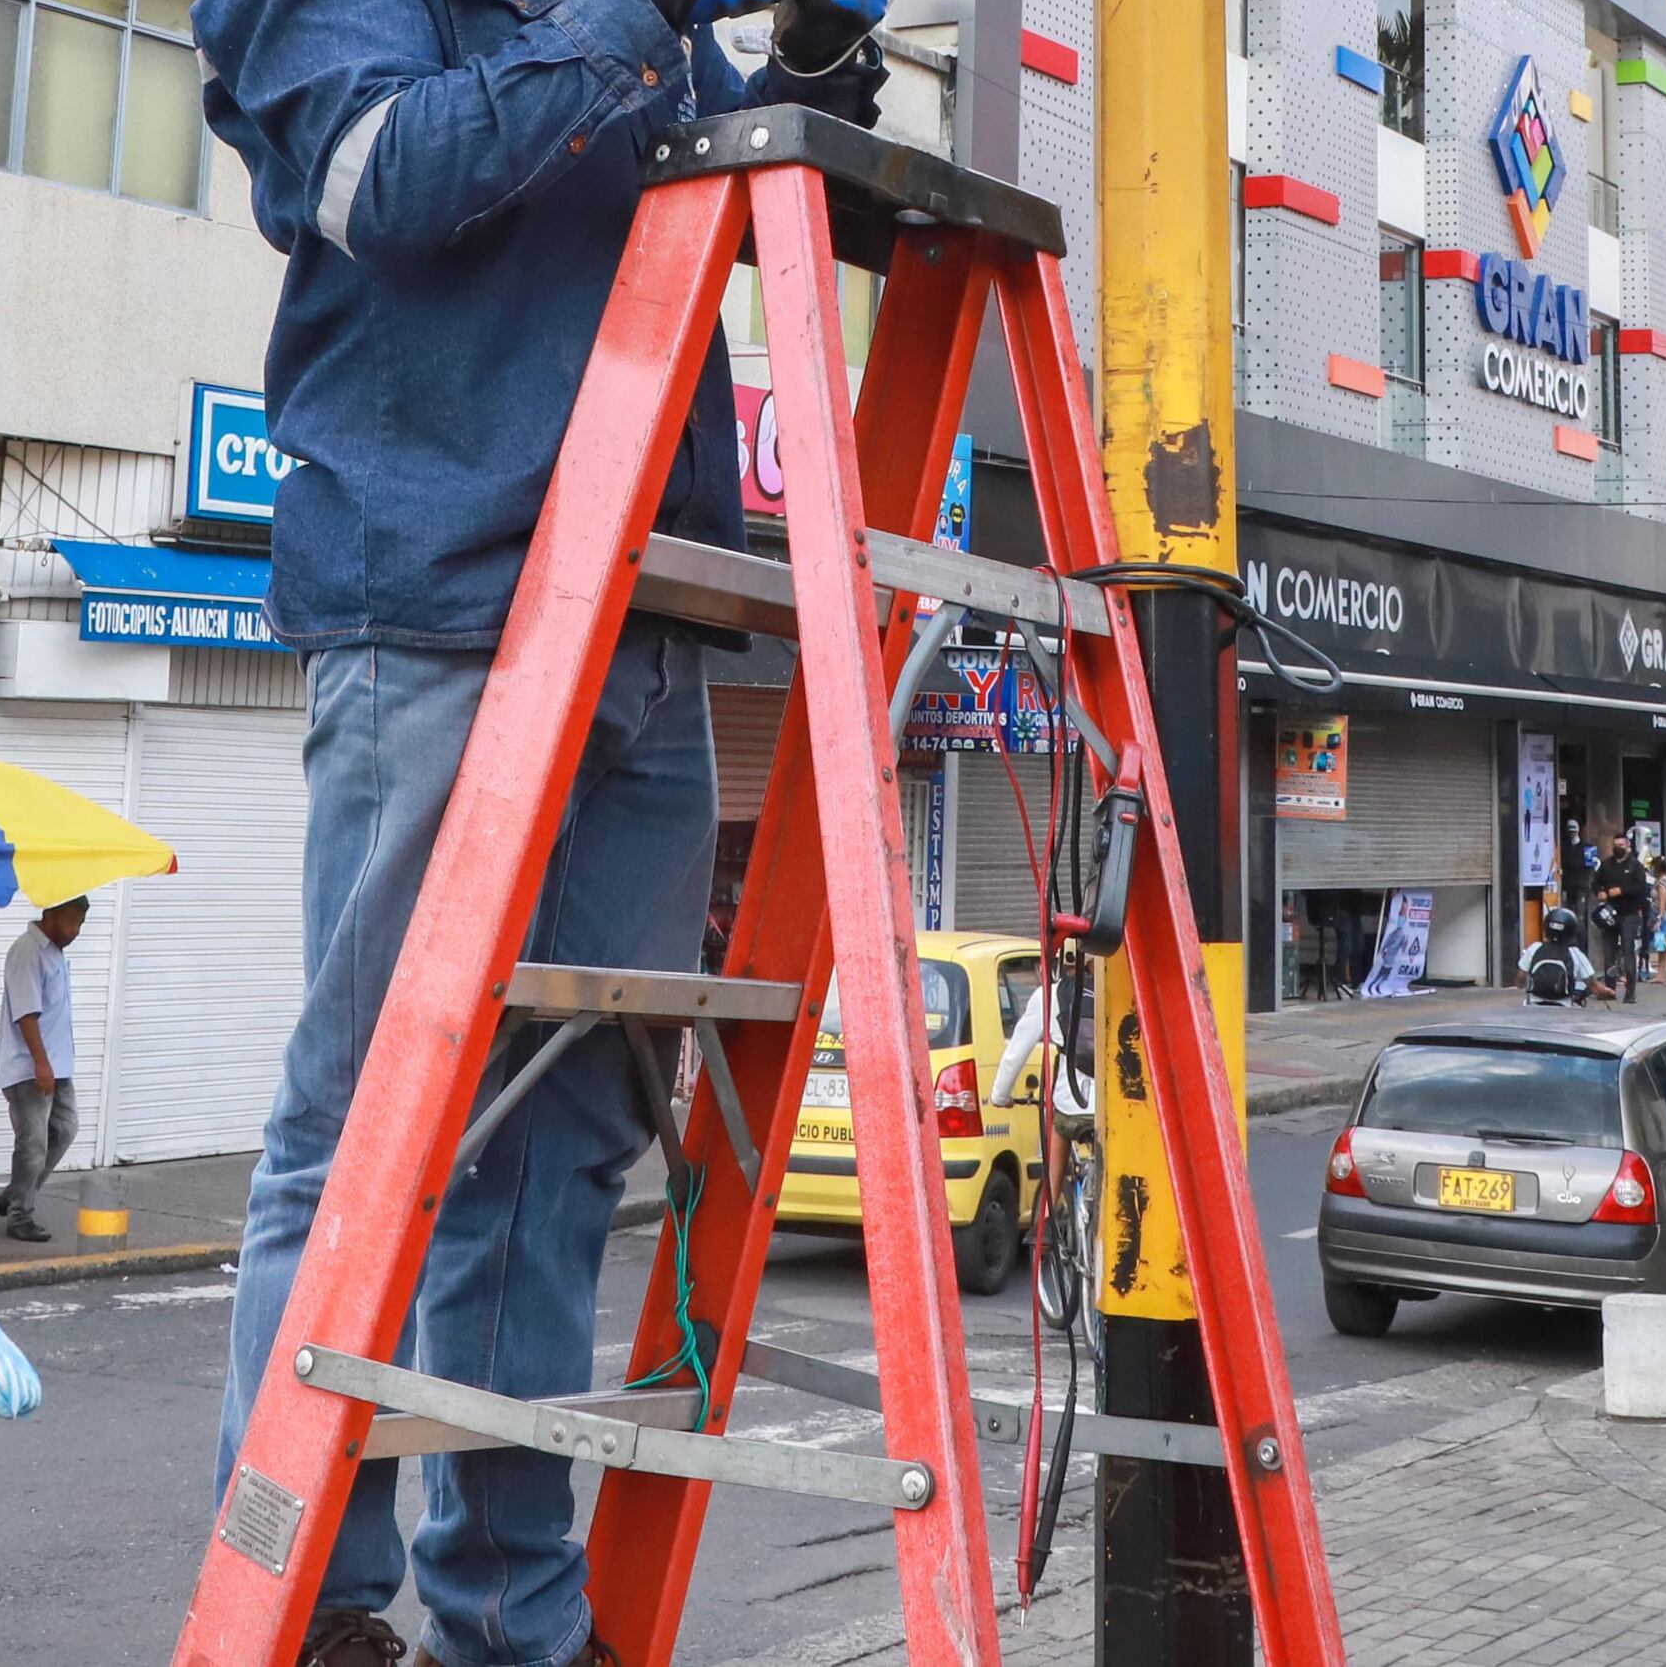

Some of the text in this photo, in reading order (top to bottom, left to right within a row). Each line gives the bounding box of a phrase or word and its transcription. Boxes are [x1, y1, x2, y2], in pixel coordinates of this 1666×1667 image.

[1475, 252, 1590, 365] GRAN
[1484, 343, 1589, 421] COMERCIO
[216, 433, 310, 481] cro
[234, 611, 280, 643] CALZA
[1276, 567, 1403, 632] COMERCIO
